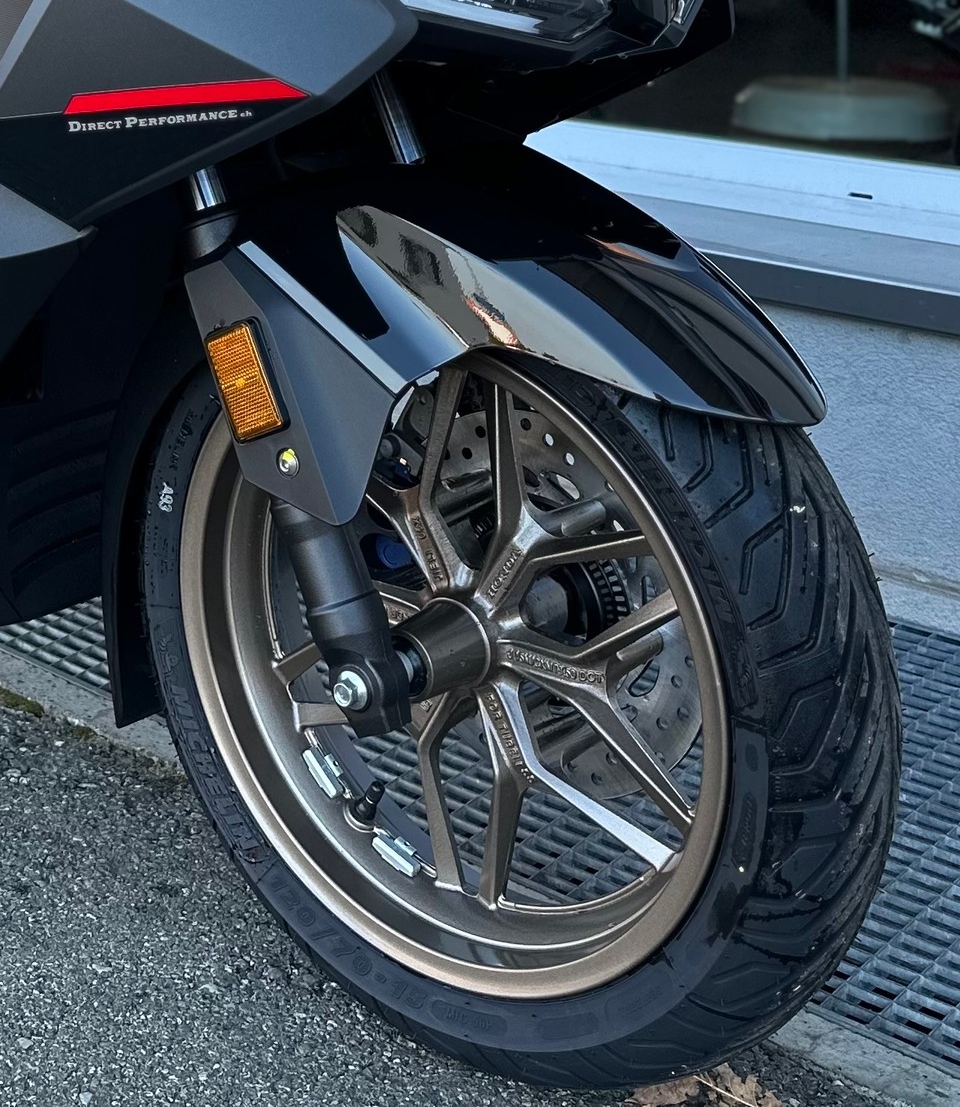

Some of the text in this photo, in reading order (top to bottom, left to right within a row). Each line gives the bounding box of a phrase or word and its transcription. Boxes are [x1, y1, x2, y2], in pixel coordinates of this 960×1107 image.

[68, 120, 122, 133] DIRECT
[124, 109, 238, 129] PERFORMANCE
[487, 548, 523, 599] HONDA
[171, 684, 260, 851] MICHELIN
